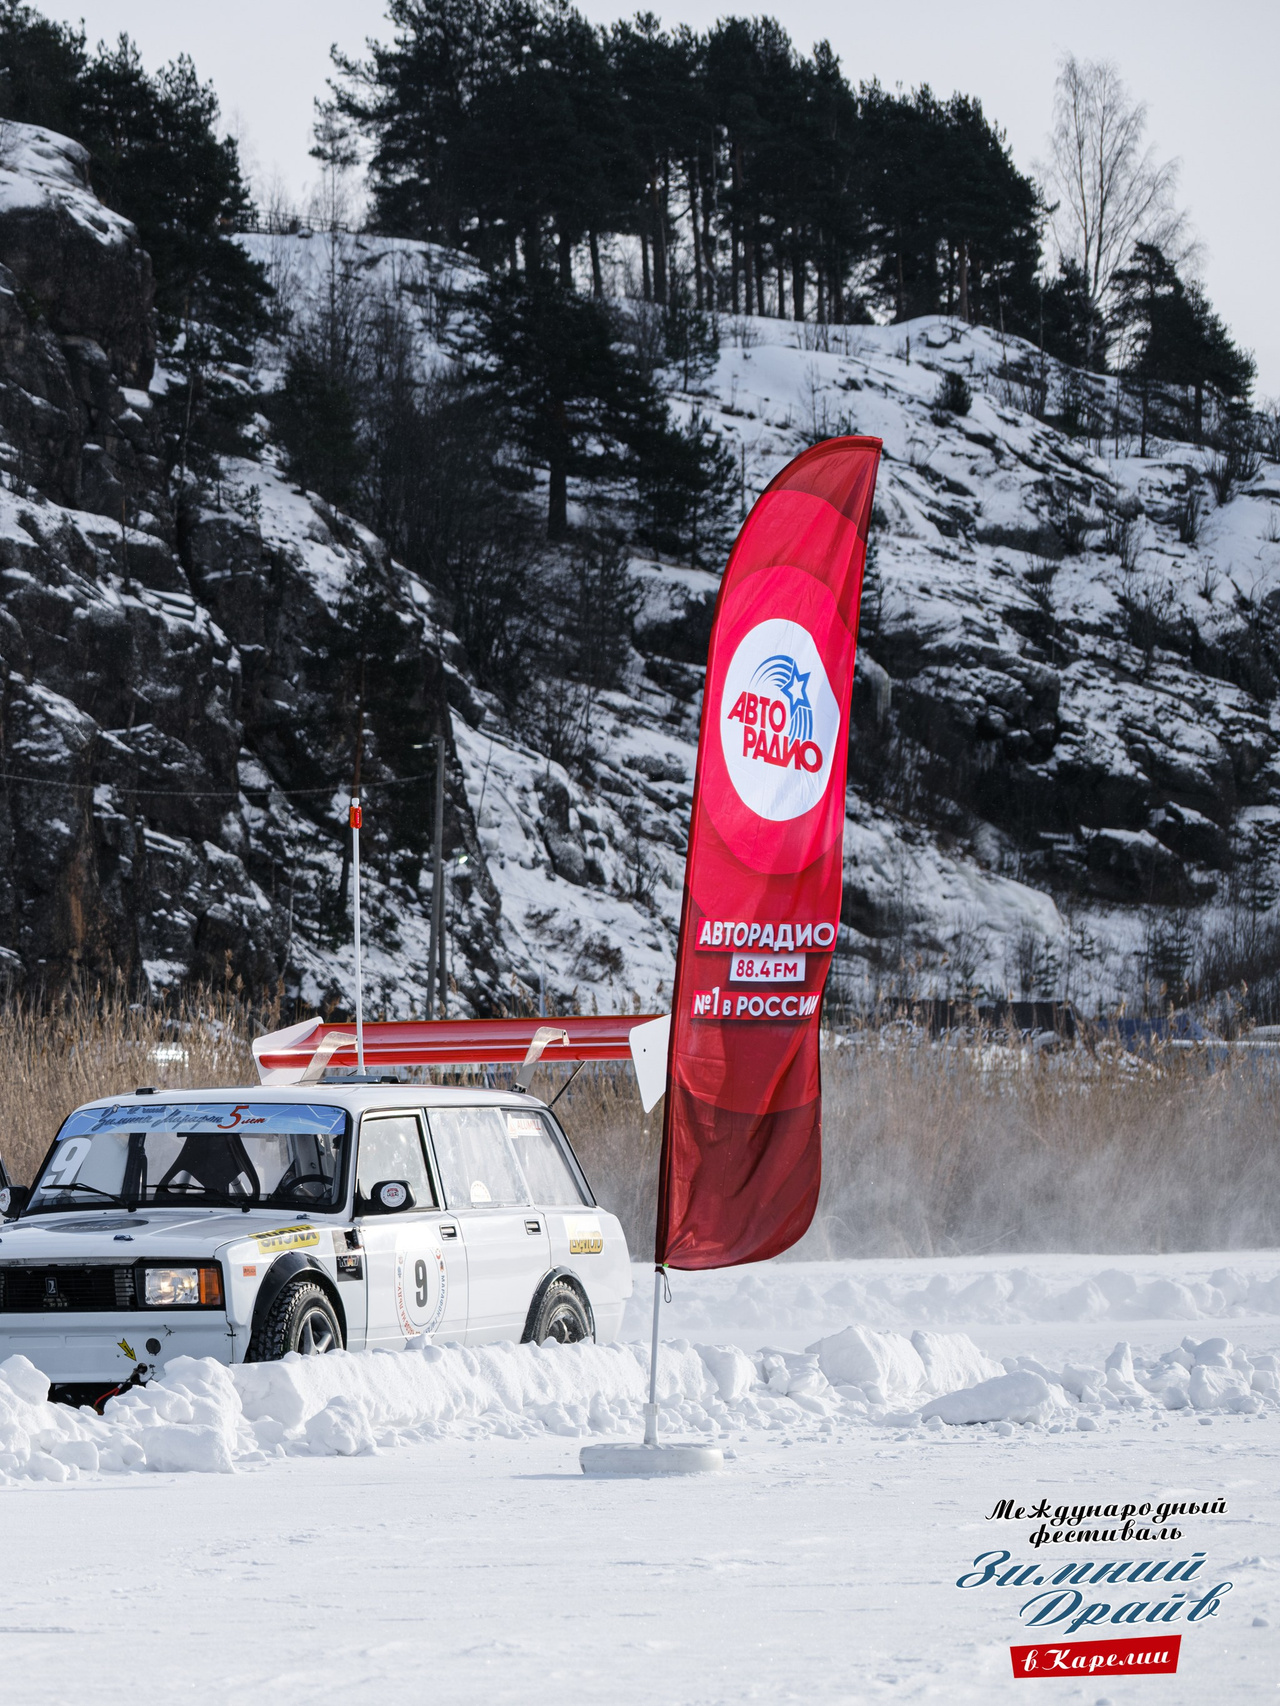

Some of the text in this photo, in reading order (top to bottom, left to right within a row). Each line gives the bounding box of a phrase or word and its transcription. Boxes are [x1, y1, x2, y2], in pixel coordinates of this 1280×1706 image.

[727, 691, 786, 733] АВТО
[742, 725, 823, 773] РАДИО
[699, 920, 835, 952] АВТОРАДИО
[736, 959, 798, 978] 88.4 FM
[694, 986, 720, 1015] №1
[736, 995, 820, 1017] РОССИИ
[217, 1105, 250, 1129] 5
[40, 1137, 92, 1195] 9
[414, 1259, 428, 1308] 9
